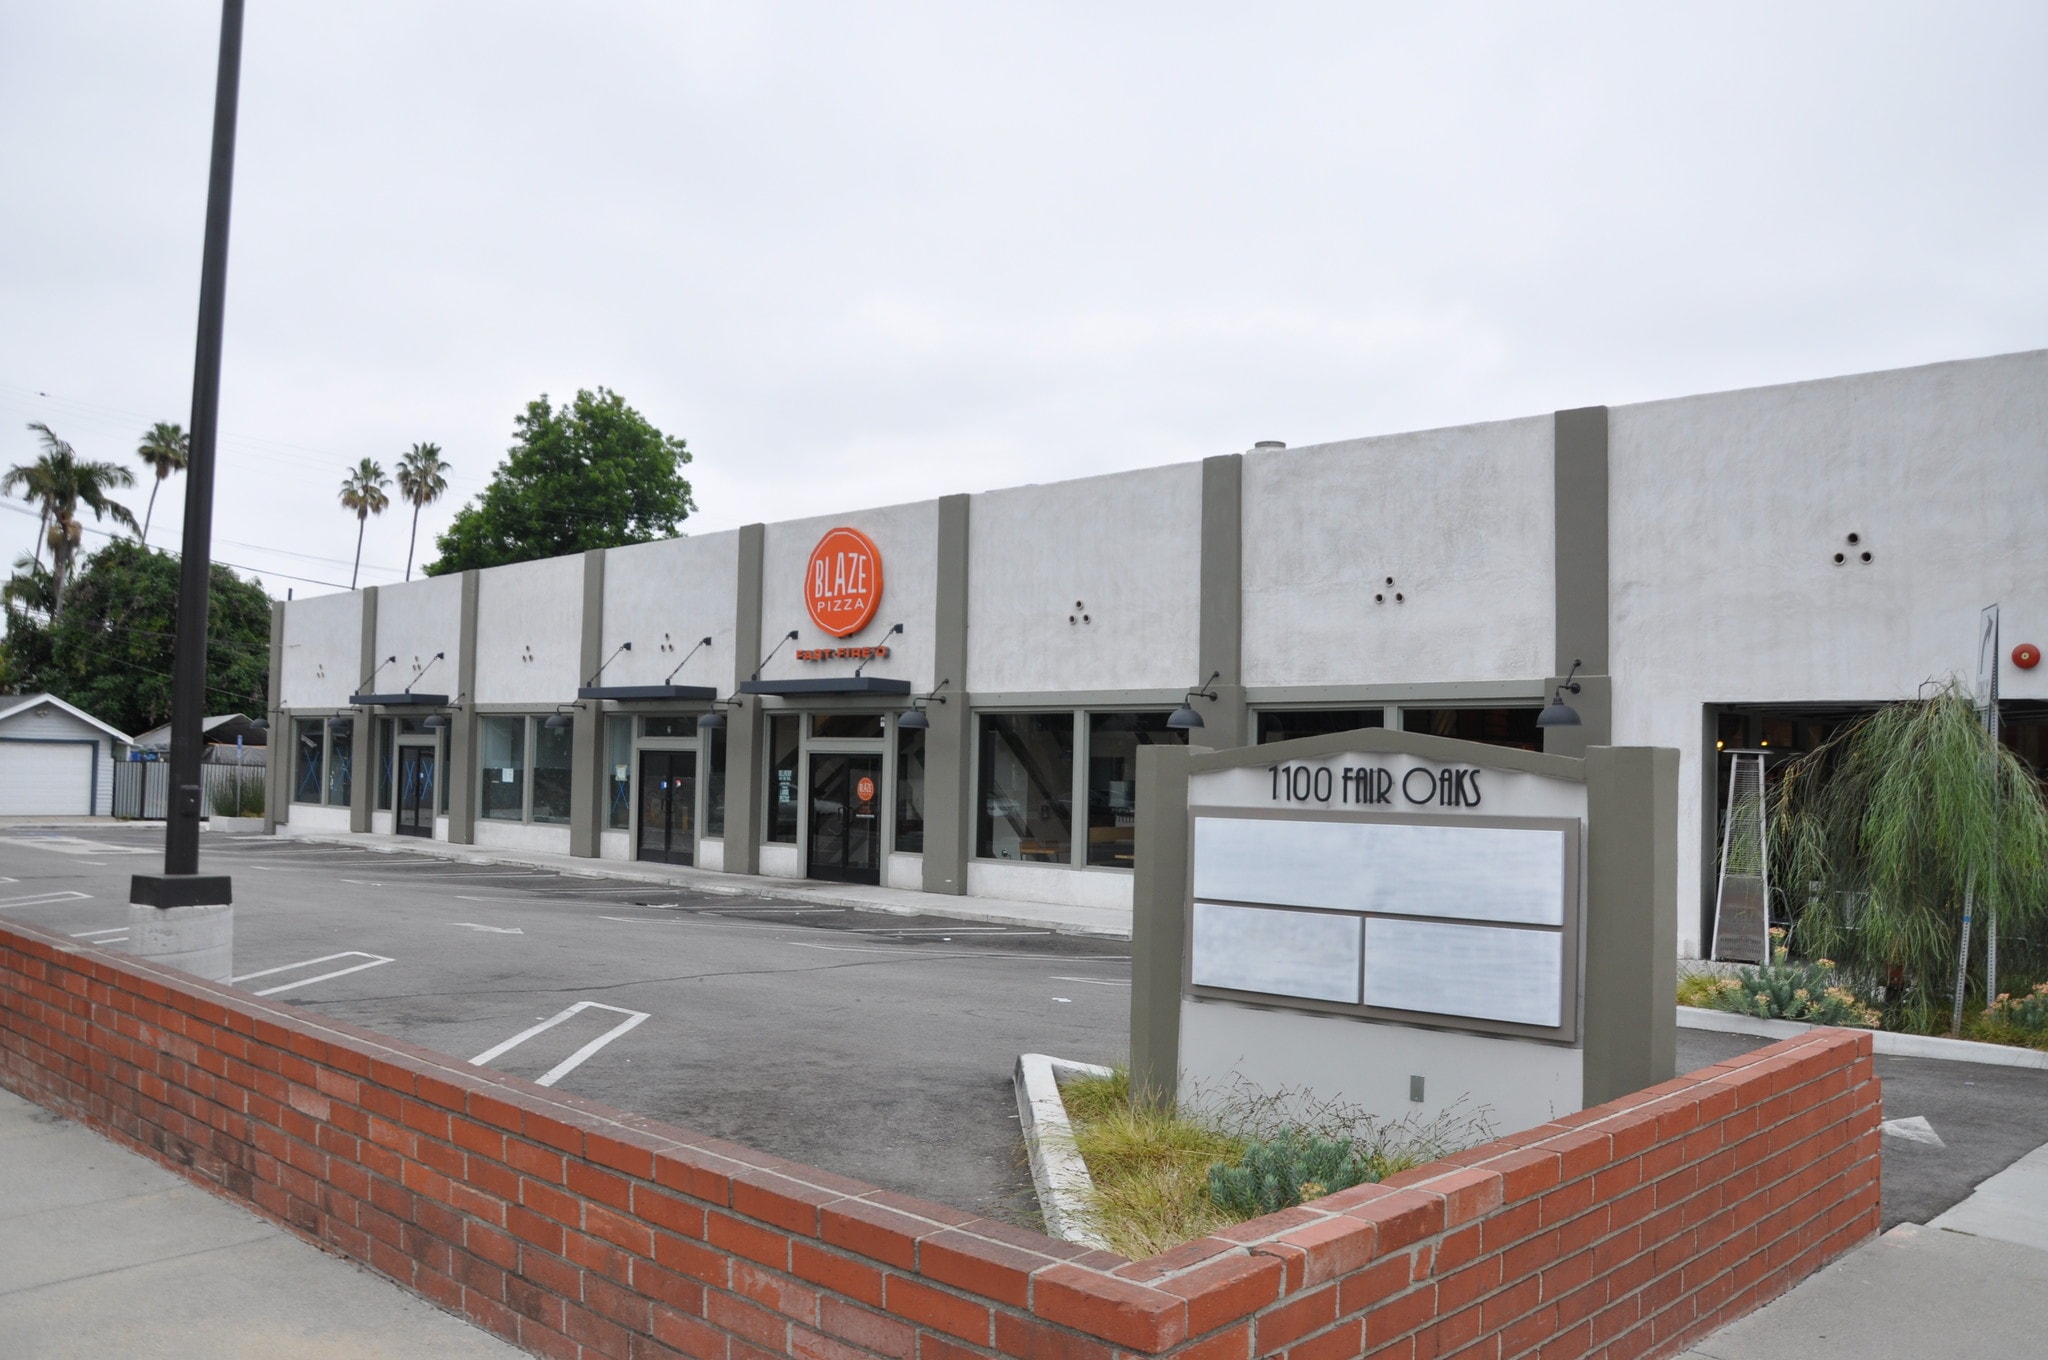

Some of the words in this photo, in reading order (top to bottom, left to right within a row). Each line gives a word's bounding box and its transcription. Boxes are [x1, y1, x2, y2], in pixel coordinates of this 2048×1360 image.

[815, 552, 867, 598] BLAZE
[817, 598, 865, 613] PIZZA
[1268, 765, 1333, 803] 1100
[1341, 767, 1393, 804] FAIR
[1402, 767, 1482, 807] OAKS
